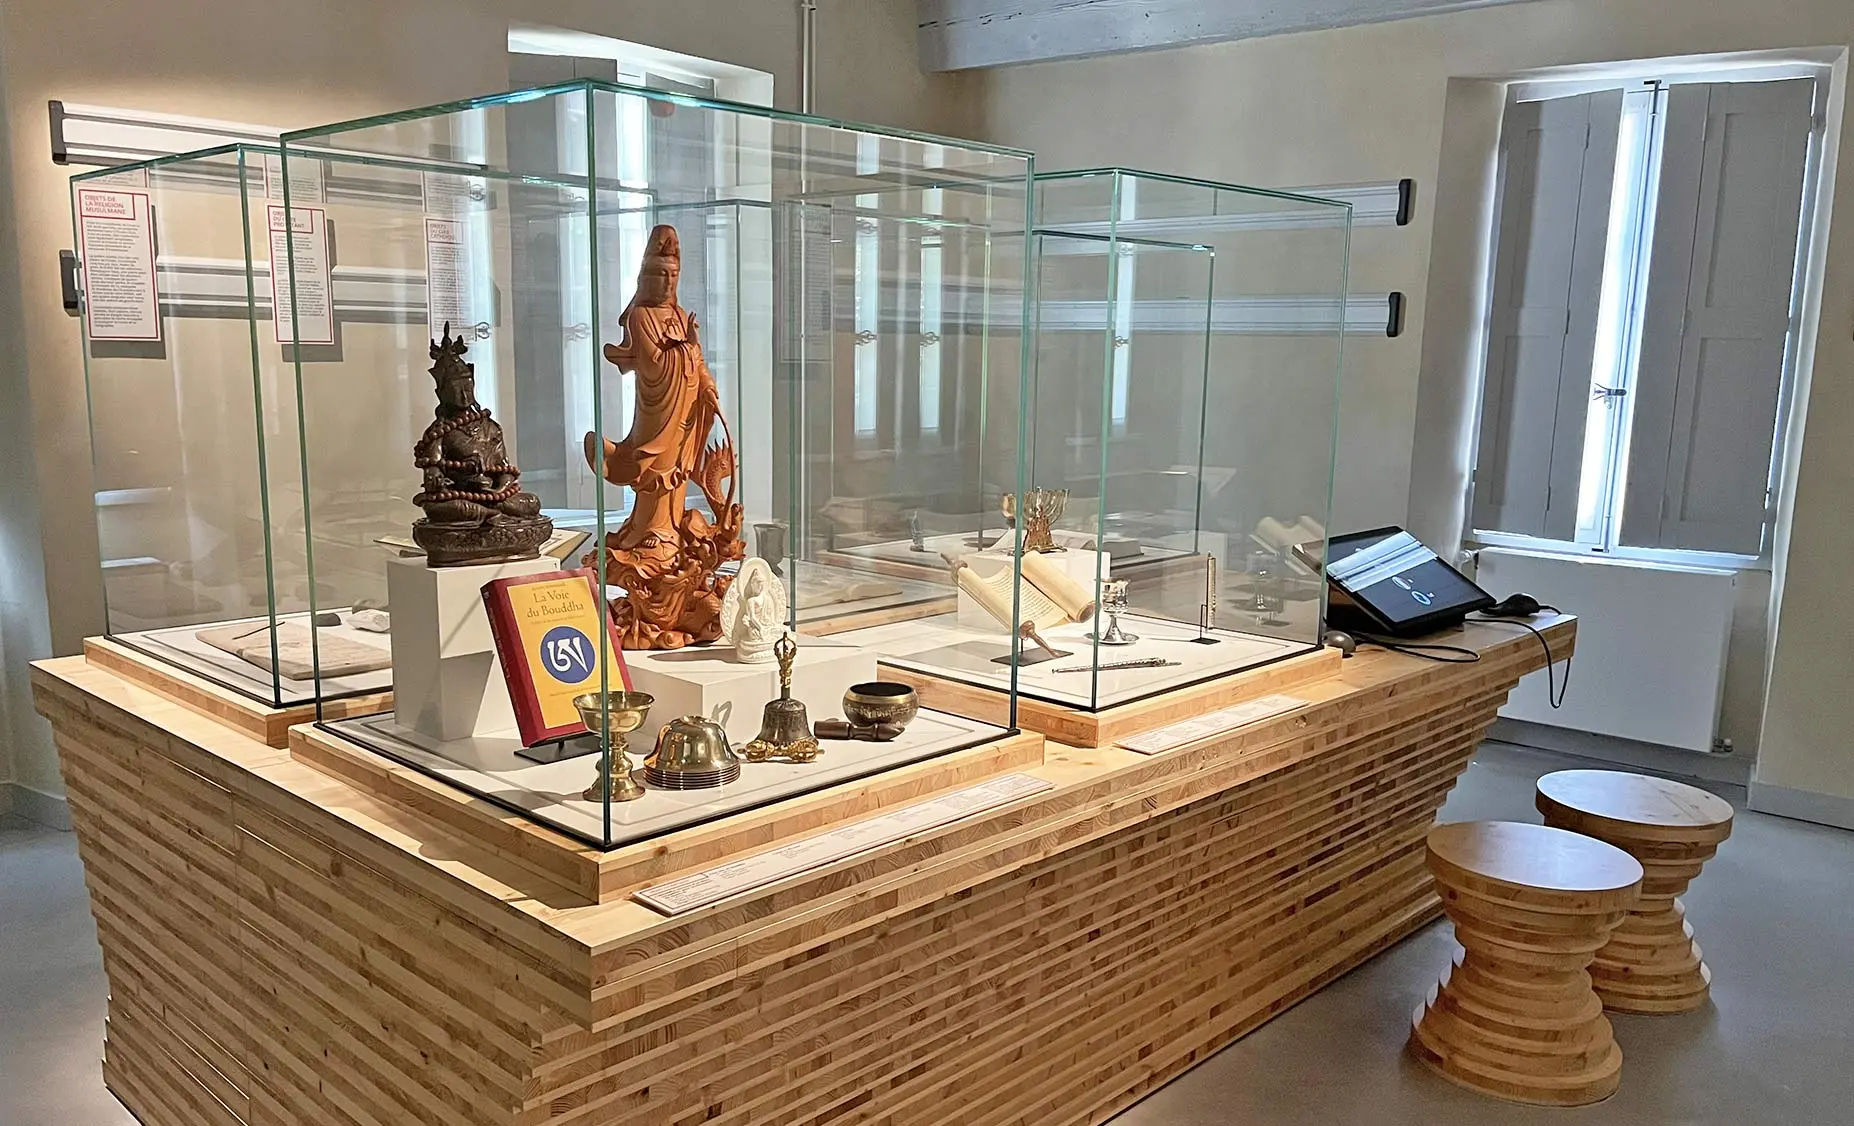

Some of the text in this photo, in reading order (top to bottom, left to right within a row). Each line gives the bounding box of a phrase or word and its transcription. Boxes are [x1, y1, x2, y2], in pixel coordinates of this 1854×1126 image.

[533, 589, 570, 603] La Voie
[527, 600, 584, 618] du Bouddha
